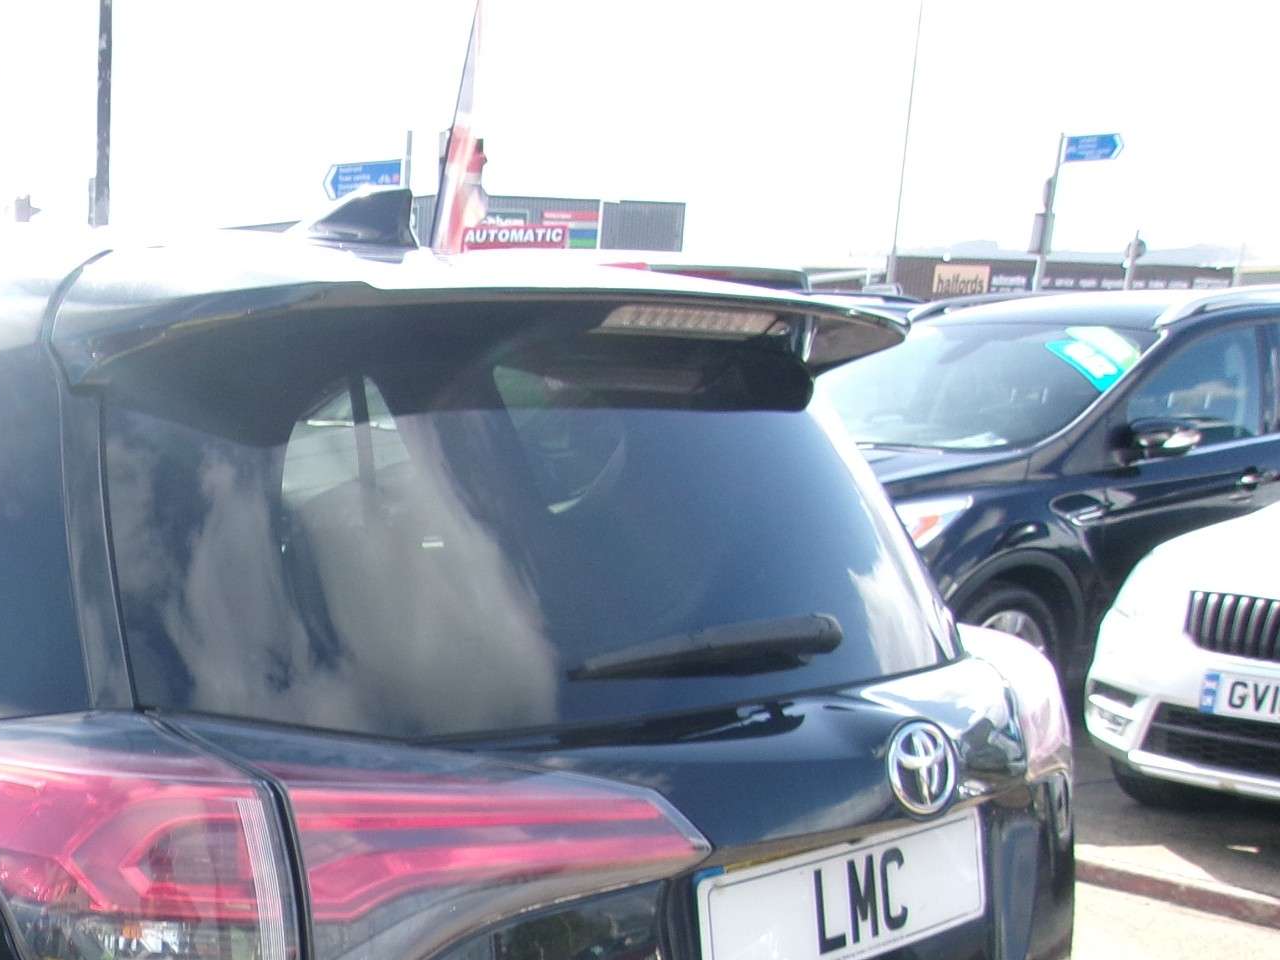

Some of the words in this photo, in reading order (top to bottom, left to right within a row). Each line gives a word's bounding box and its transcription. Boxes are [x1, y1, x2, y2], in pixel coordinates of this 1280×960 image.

[465, 227, 563, 243] AUTOMATIC
[935, 272, 985, 296] halfords
[813, 847, 909, 955] LMC
